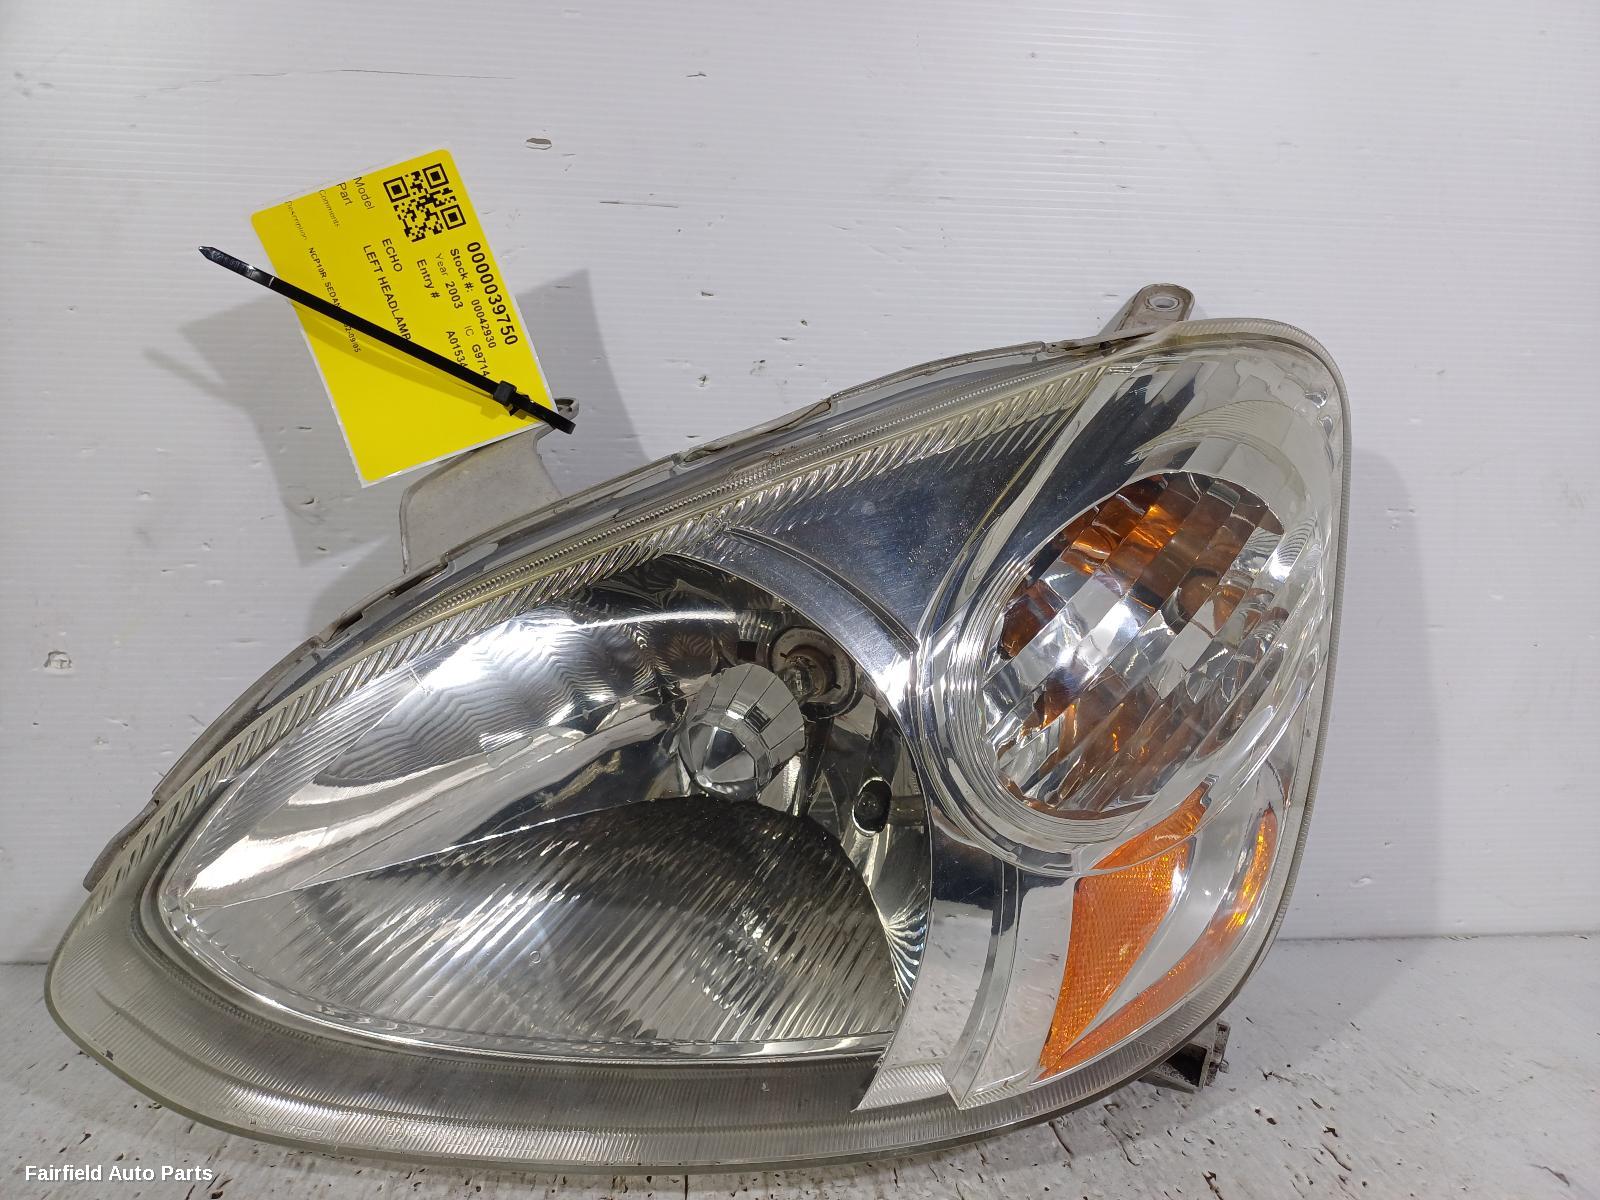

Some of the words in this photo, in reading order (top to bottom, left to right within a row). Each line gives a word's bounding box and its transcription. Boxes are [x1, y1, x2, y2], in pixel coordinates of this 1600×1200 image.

[336, 181, 353, 206] Part
[363, 244, 384, 273] LEFT
[377, 276, 412, 341] HEADLAMP
[353, 176, 375, 210] Model
[382, 238, 403, 272] ECHO
[417, 259, 435, 289] Entry
[430, 290, 441, 299] #
[435, 252, 448, 276] Year
[445, 281, 464, 309] 2003
[450, 248, 469, 280] Stock
[471, 299, 497, 349] 00042930
[467, 241, 518, 345] 0000039750
[471, 344, 490, 376] G9714
